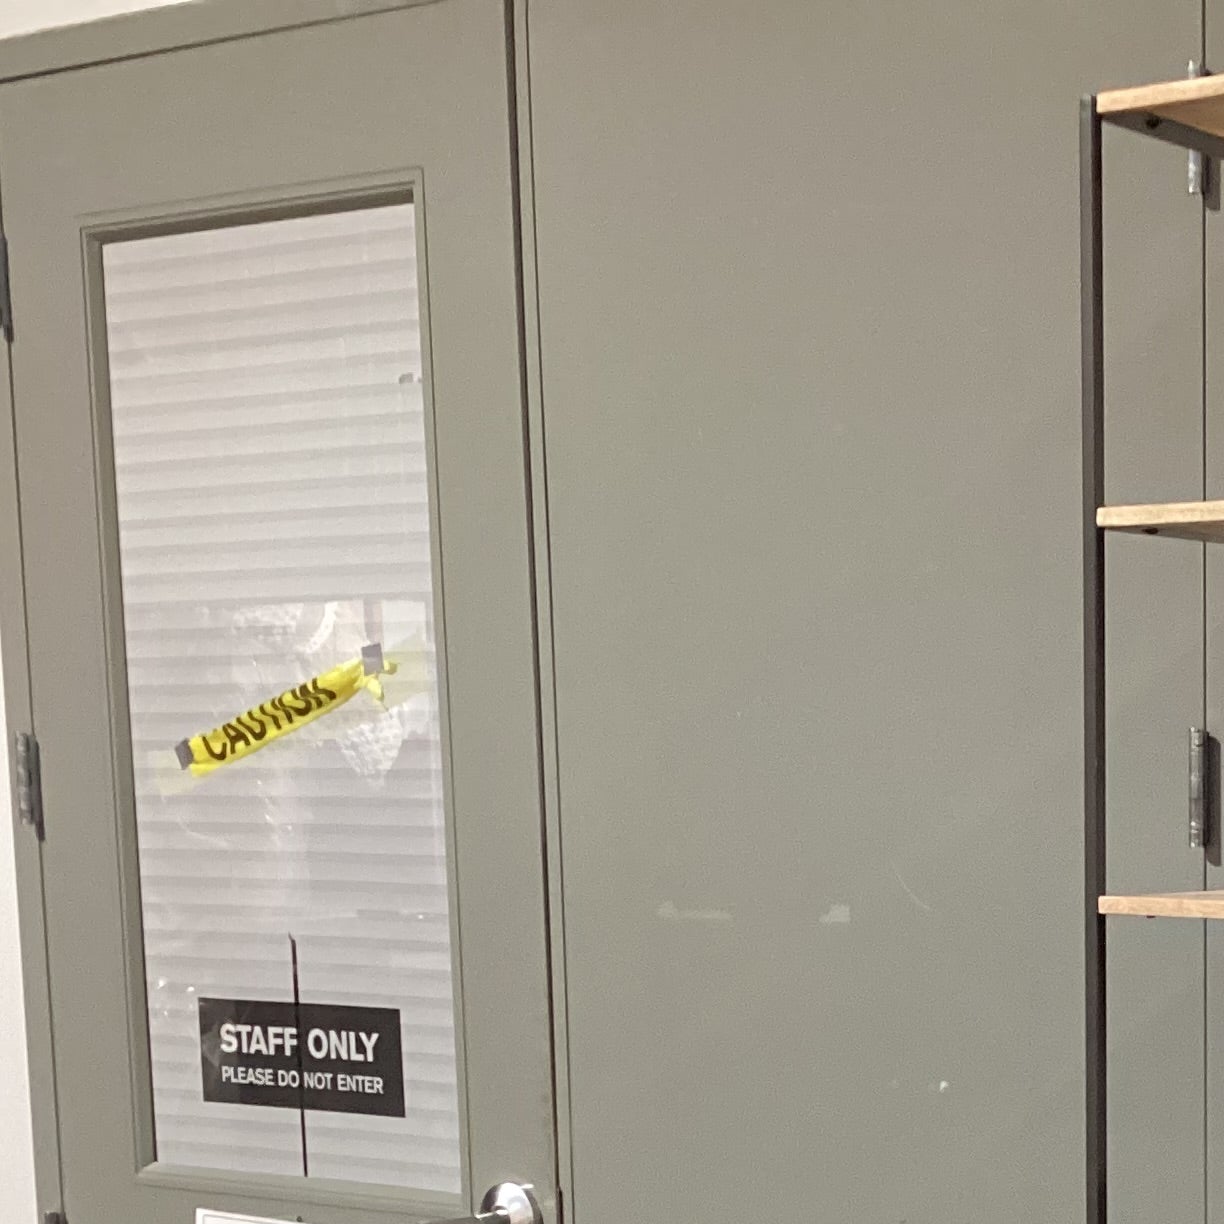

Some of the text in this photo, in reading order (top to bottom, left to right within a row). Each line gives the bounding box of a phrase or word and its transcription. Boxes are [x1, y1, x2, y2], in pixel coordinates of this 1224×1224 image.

[220, 1023, 379, 1062] STAFF ONLY
[222, 1066, 384, 1094] PLEASE DO NOT ENTER
